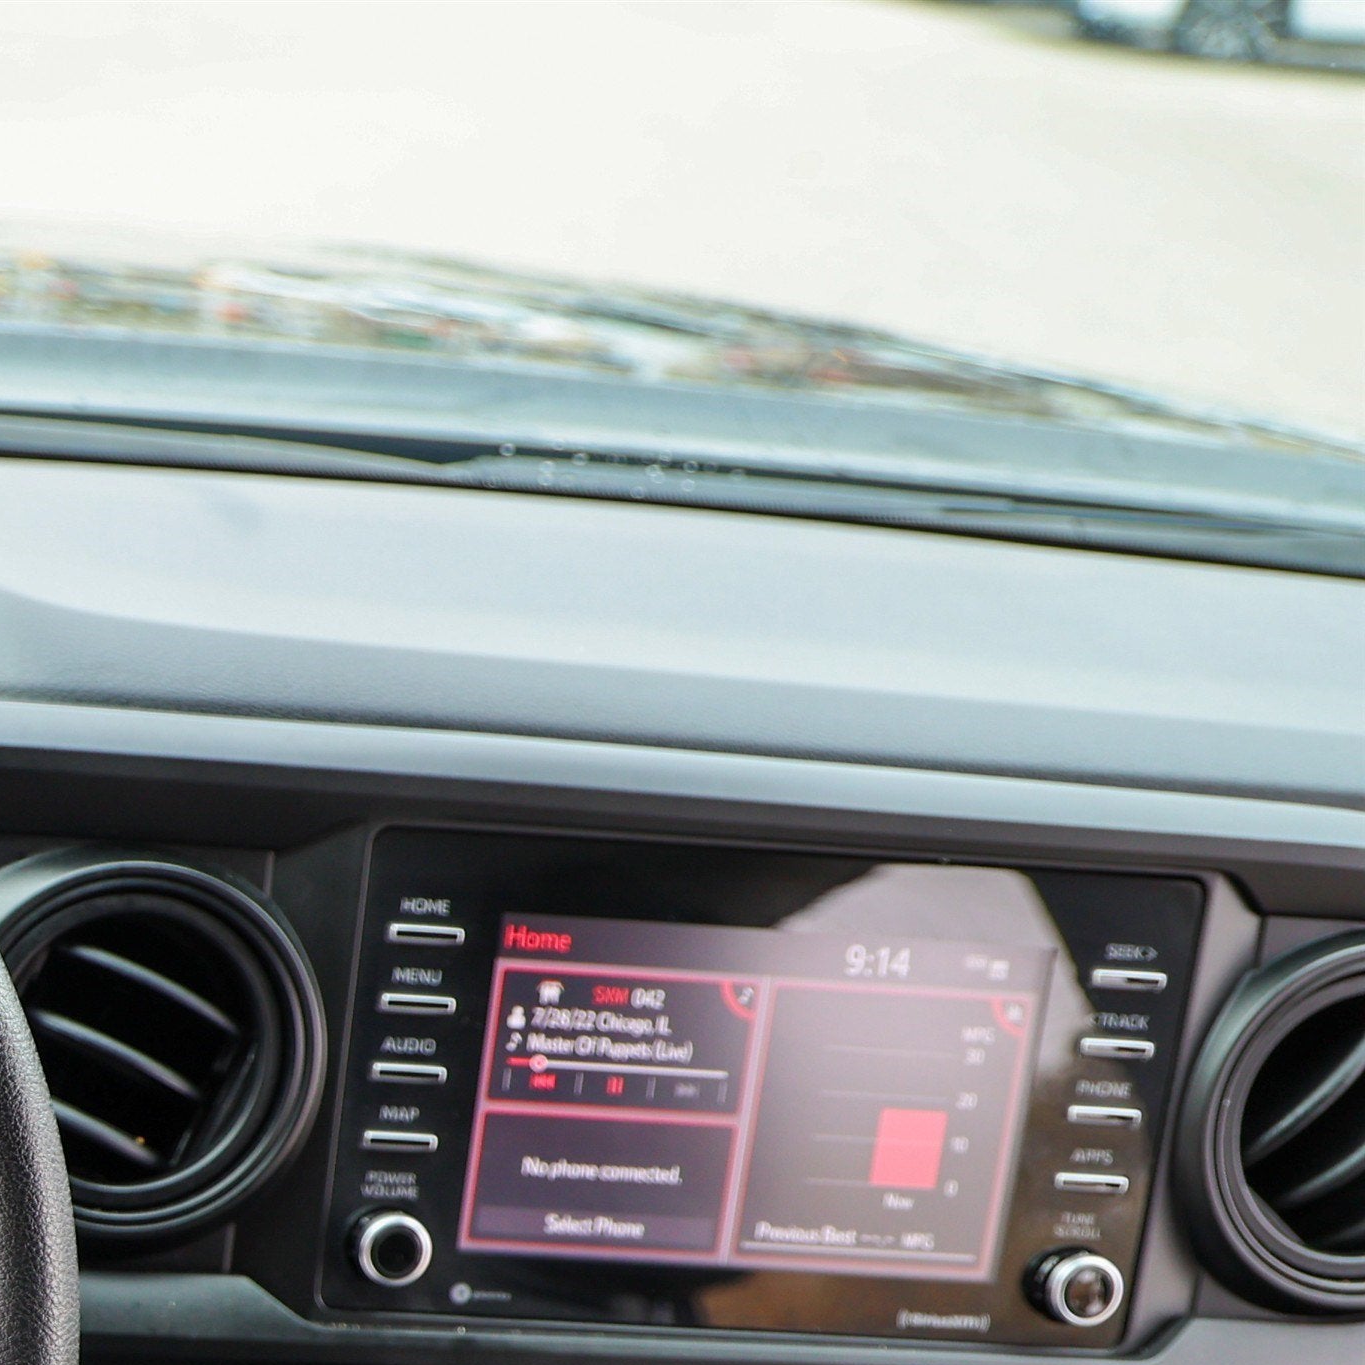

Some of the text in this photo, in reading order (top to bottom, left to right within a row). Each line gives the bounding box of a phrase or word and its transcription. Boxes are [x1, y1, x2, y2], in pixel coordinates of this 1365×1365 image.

[400, 898, 451, 917] HOME
[503, 924, 572, 953] Home
[844, 944, 911, 979] 9:14
[392, 967, 443, 986] MENU
[380, 1036, 437, 1056] AUDIO
[379, 1105, 420, 1122] MAP
[521, 1155, 683, 1186] No phone connected.
[543, 1213, 645, 1239] Select Phone
